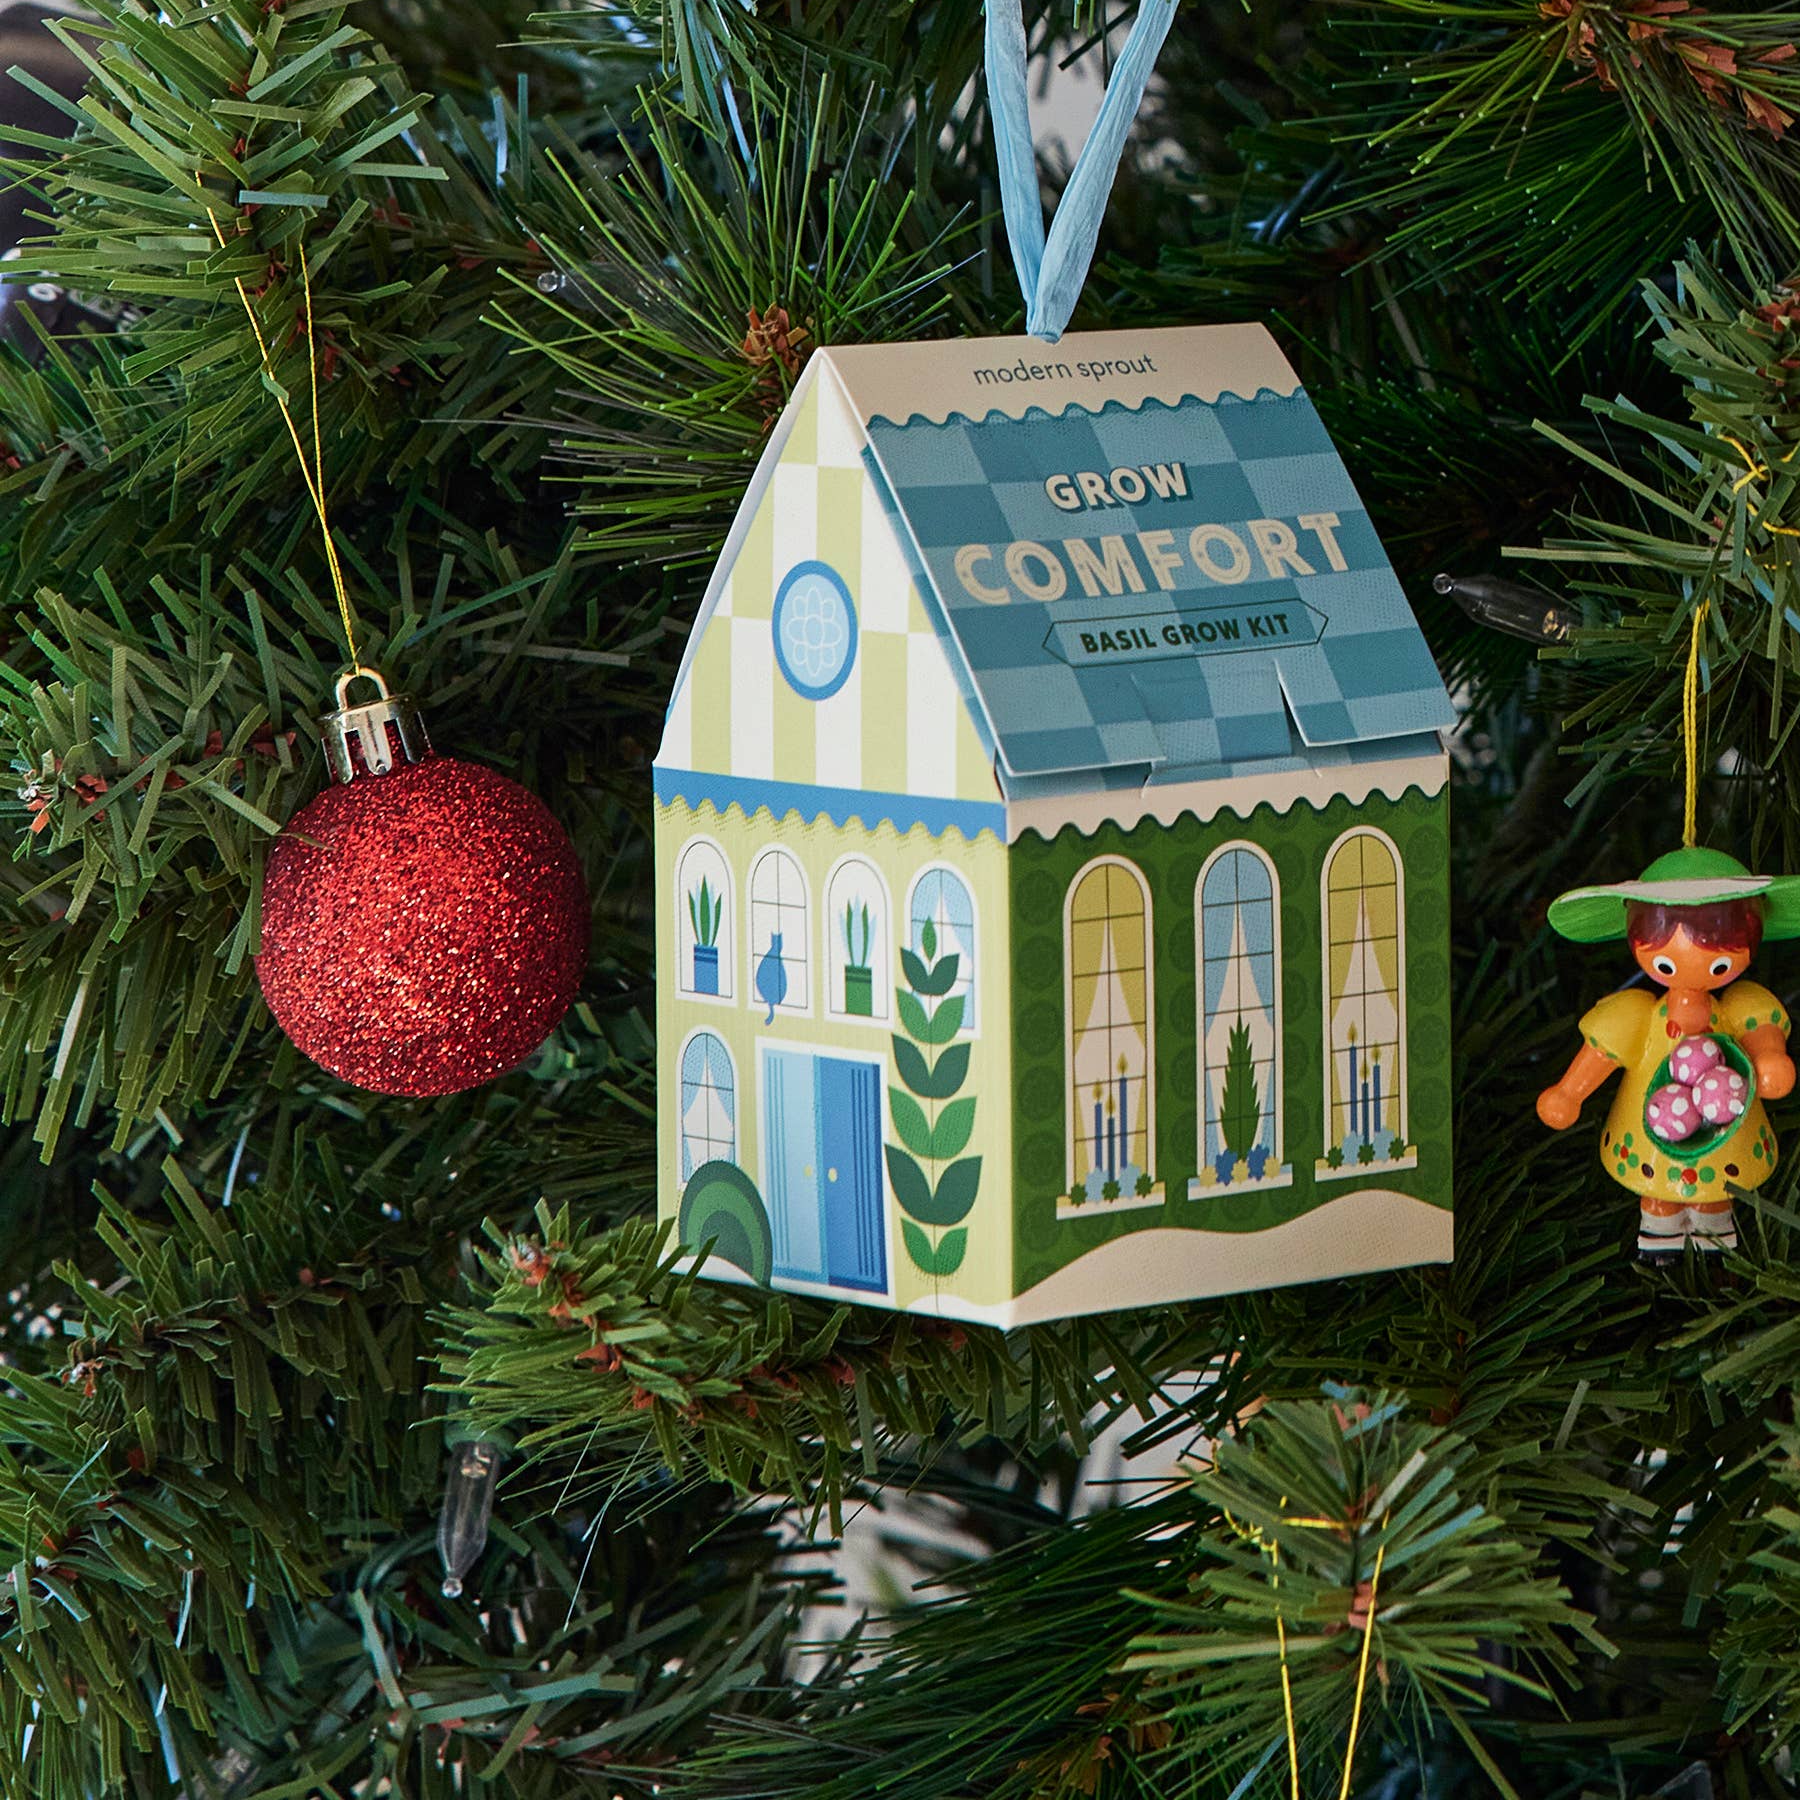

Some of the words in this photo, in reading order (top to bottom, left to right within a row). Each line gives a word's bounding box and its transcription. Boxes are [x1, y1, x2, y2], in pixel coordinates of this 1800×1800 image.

[973, 357, 1072, 387] modern
[1077, 353, 1159, 383] sprout
[1045, 462, 1193, 512] GROW
[953, 512, 1350, 605] COMFORT
[1080, 627, 1157, 655] BASIL
[1162, 620, 1241, 646] GROW
[1246, 613, 1291, 637] KIT
